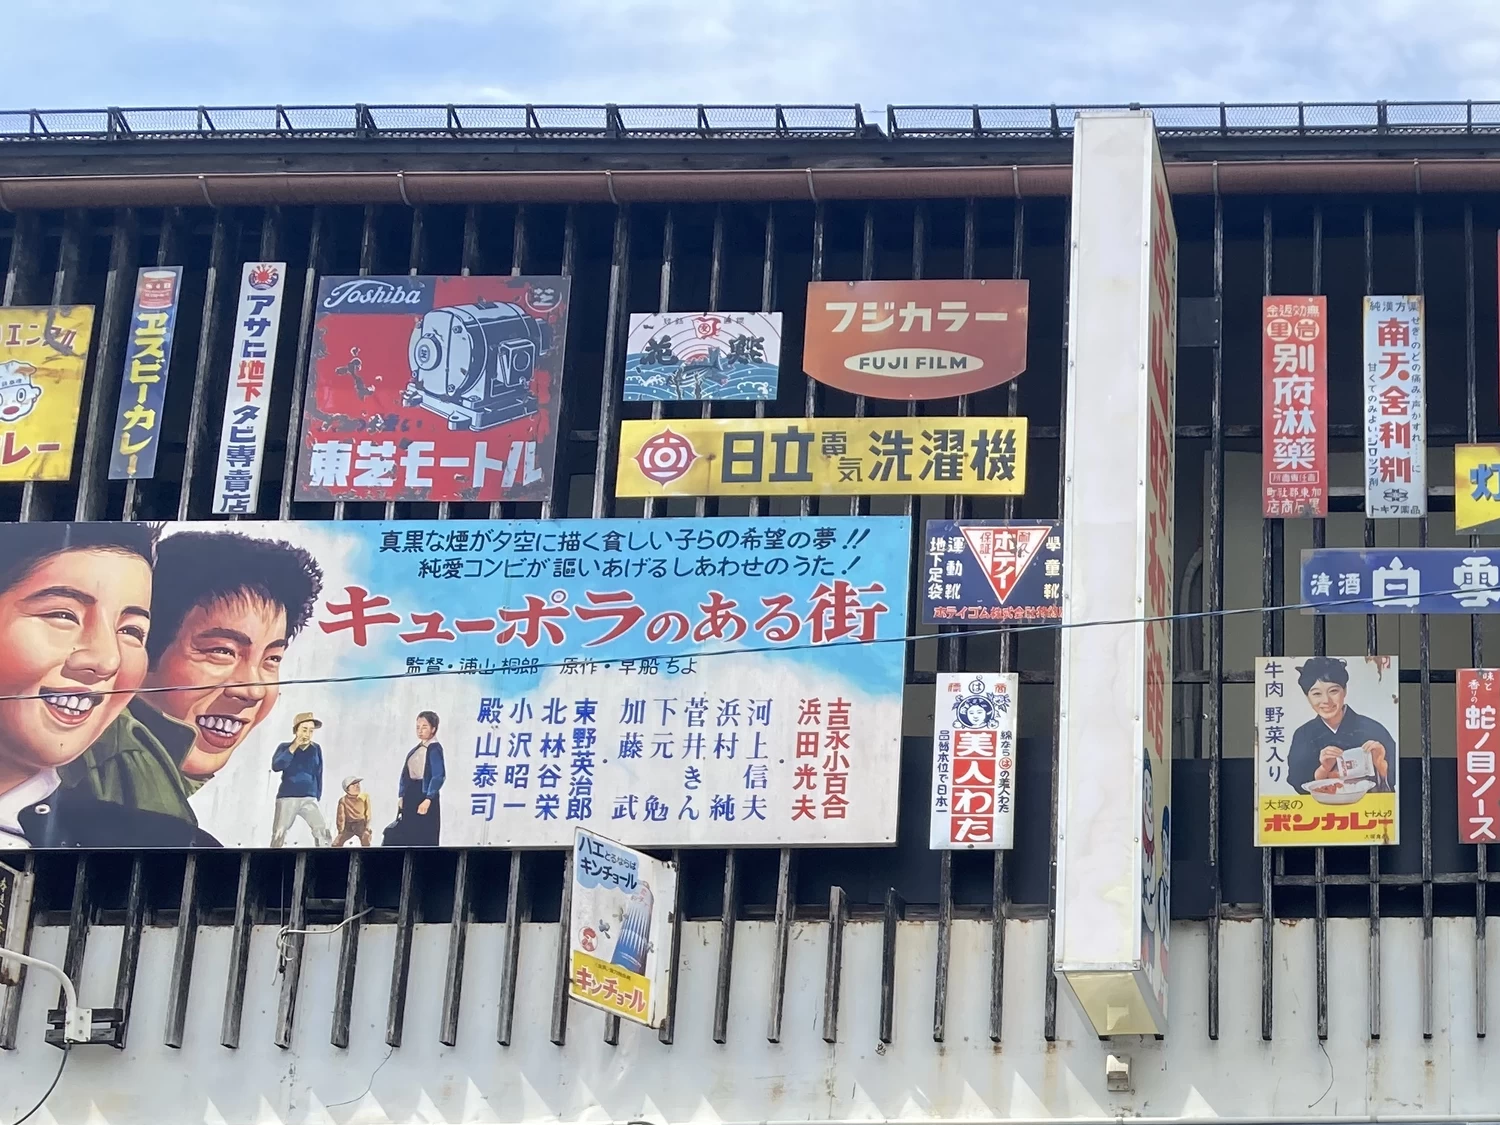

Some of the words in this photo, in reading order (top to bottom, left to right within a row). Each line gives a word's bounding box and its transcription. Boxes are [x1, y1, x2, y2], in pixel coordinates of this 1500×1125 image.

[324, 280, 421, 308] Toshiba
[826, 302, 1008, 333] フジカラー
[859, 357, 908, 370] FUJI
[915, 357, 968, 370] FILM
[309, 440, 542, 488] 東芝モートル
[928, 537, 946, 599] 地下足袋
[945, 536, 964, 599] 運動靴
[993, 531, 1016, 589] ホテイ
[1310, 573, 1362, 597] 清酒
[319, 580, 889, 648] キューポラのある街
[1264, 662, 1285, 697] 牛肉
[471, 697, 501, 821] 殿山泰司
[503, 697, 533, 809] 小沢昭一
[535, 697, 567, 821] 北林谷栄
[565, 698, 599, 821] 東野英治郎
[611, 697, 645, 821] 加藤武
[642, 697, 676, 821] 下元勉
[678, 696, 709, 821] 菅井きん
[709, 697, 741, 821] 浜村純
[741, 697, 773, 821] 河上信夫
[791, 697, 822, 821] 浜田光夫
[821, 697, 852, 821] 吉永小百合
[1264, 707, 1285, 782] 野菜入り
[1465, 705, 1496, 839] 蛇ノ目ソース
[953, 732, 996, 843] 美人わた
[1264, 799, 1303, 811] 大塚の
[1264, 812, 1393, 832] ボンカレー
[580, 857, 637, 891] キンチョール
[576, 966, 645, 1013] キンチョール
